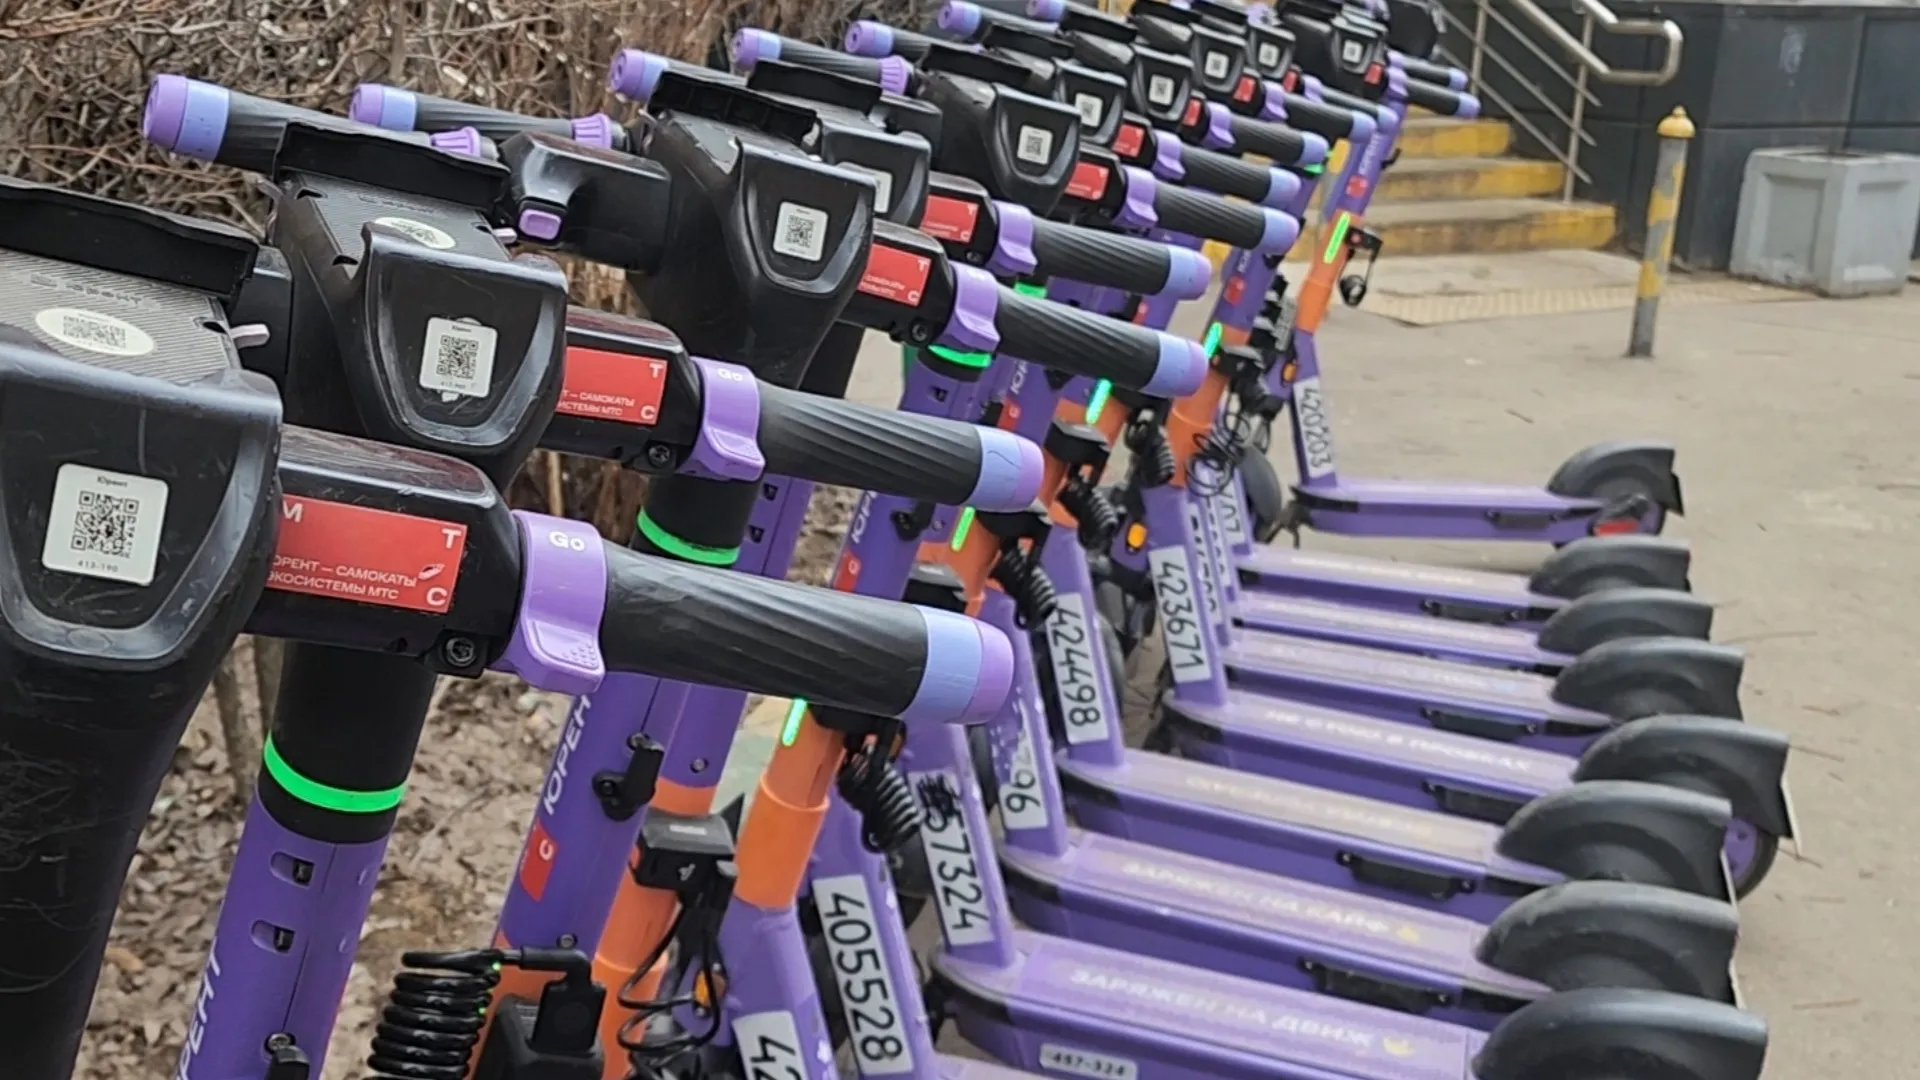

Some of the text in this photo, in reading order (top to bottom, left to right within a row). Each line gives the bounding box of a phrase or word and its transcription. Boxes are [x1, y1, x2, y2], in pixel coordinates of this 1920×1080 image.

[649, 363, 664, 379] Т
[718, 368, 743, 382] Go
[557, 400, 601, 413] ИСТЕМЫ
[640, 405, 656, 420] С
[441, 528, 462, 549] Т
[549, 531, 585, 552] Go
[336, 564, 417, 588] САМОКАТЫ
[367, 585, 400, 600] МТС
[426, 587, 448, 606] С
[1155, 561, 1205, 669] 423671
[1051, 606, 1101, 727] 424498
[544, 694, 592, 815] ЮРЕН
[918, 776, 989, 930] 57324
[824, 892, 903, 1062] 405528
[1068, 969, 1375, 1047] ЗАРЯЖЕН НА ДВИЖ
